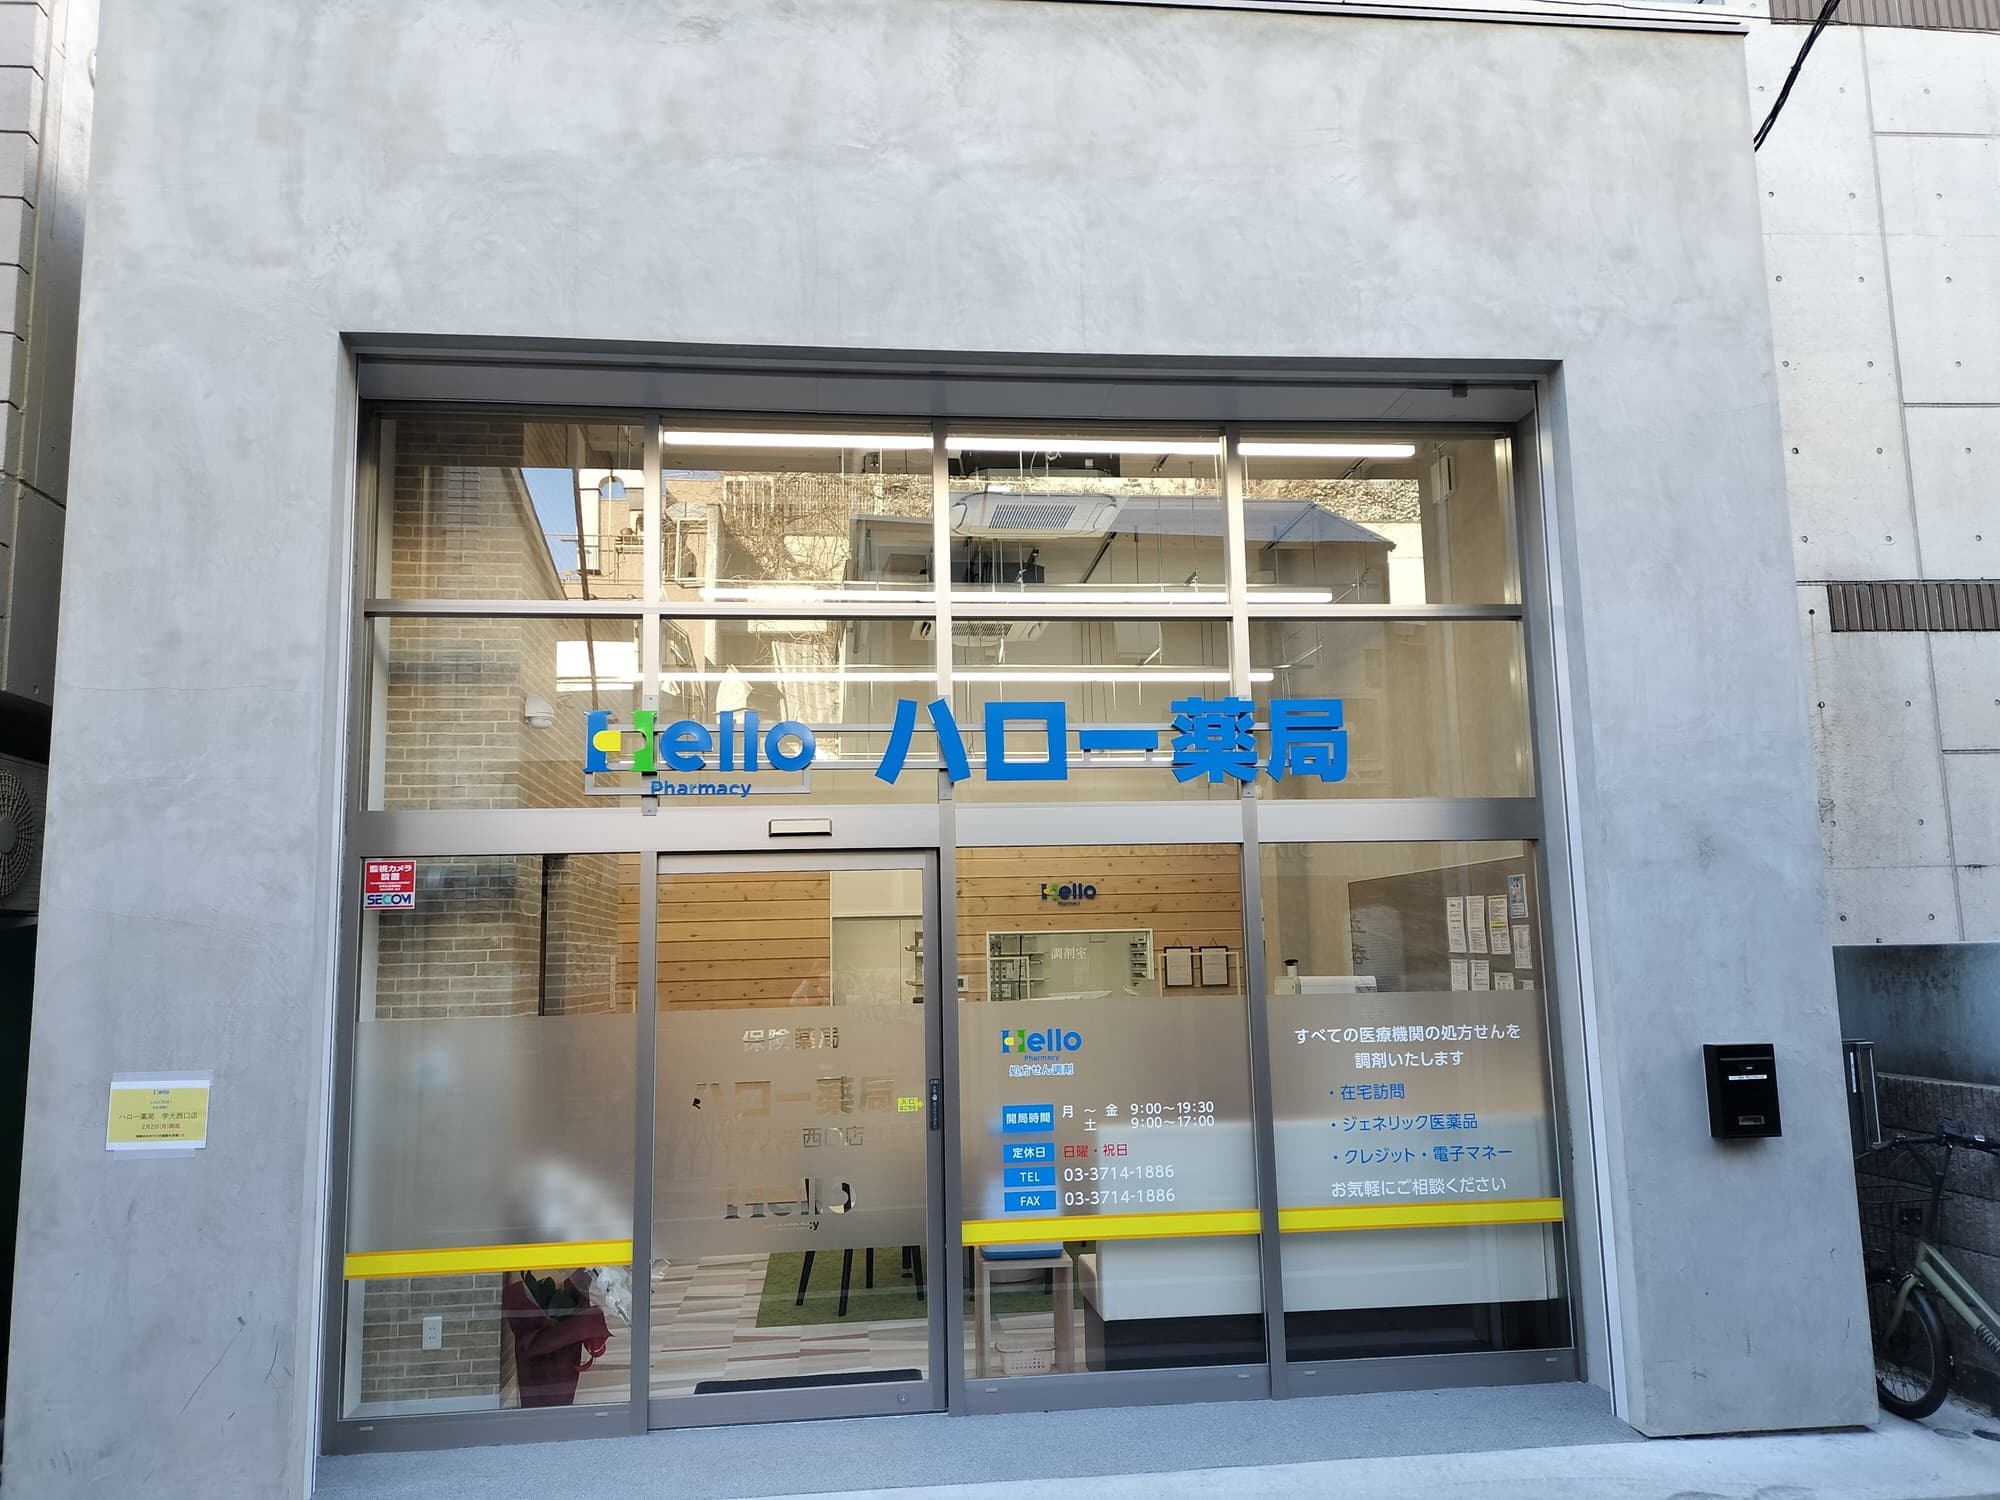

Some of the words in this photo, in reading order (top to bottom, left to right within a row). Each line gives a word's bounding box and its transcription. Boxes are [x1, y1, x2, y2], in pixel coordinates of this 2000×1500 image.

[583, 710, 816, 772] Hello
[875, 697, 1348, 785] ハロー薬局
[651, 781, 751, 797] Pharmacy
[367, 894, 412, 905] SECOM
[1041, 883, 1097, 901] Hello
[1051, 946, 1088, 960] 調剤室
[1001, 1028, 1082, 1054] Hello
[1294, 1024, 1521, 1044] すべての医療機関の処方せんを
[1354, 1050, 1464, 1069] 調剤いたします
[1008, 1063, 1074, 1077] 処方せん調剤
[1006, 1111, 1051, 1124] 開局時間
[1084, 1118, 1097, 1131] 土
[1012, 1147, 1046, 1159] 定休日
[1063, 1143, 1129, 1158] 日曜・祝日
[1020, 1171, 1040, 1182] TEL
[1063, 1165, 1175, 1182] 03-3714-1886
[1331, 1177, 1507, 1198] お気軽にご相談ください
[1020, 1195, 1041, 1206] FAX
[1064, 1188, 1176, 1206] 03-3714-1886
